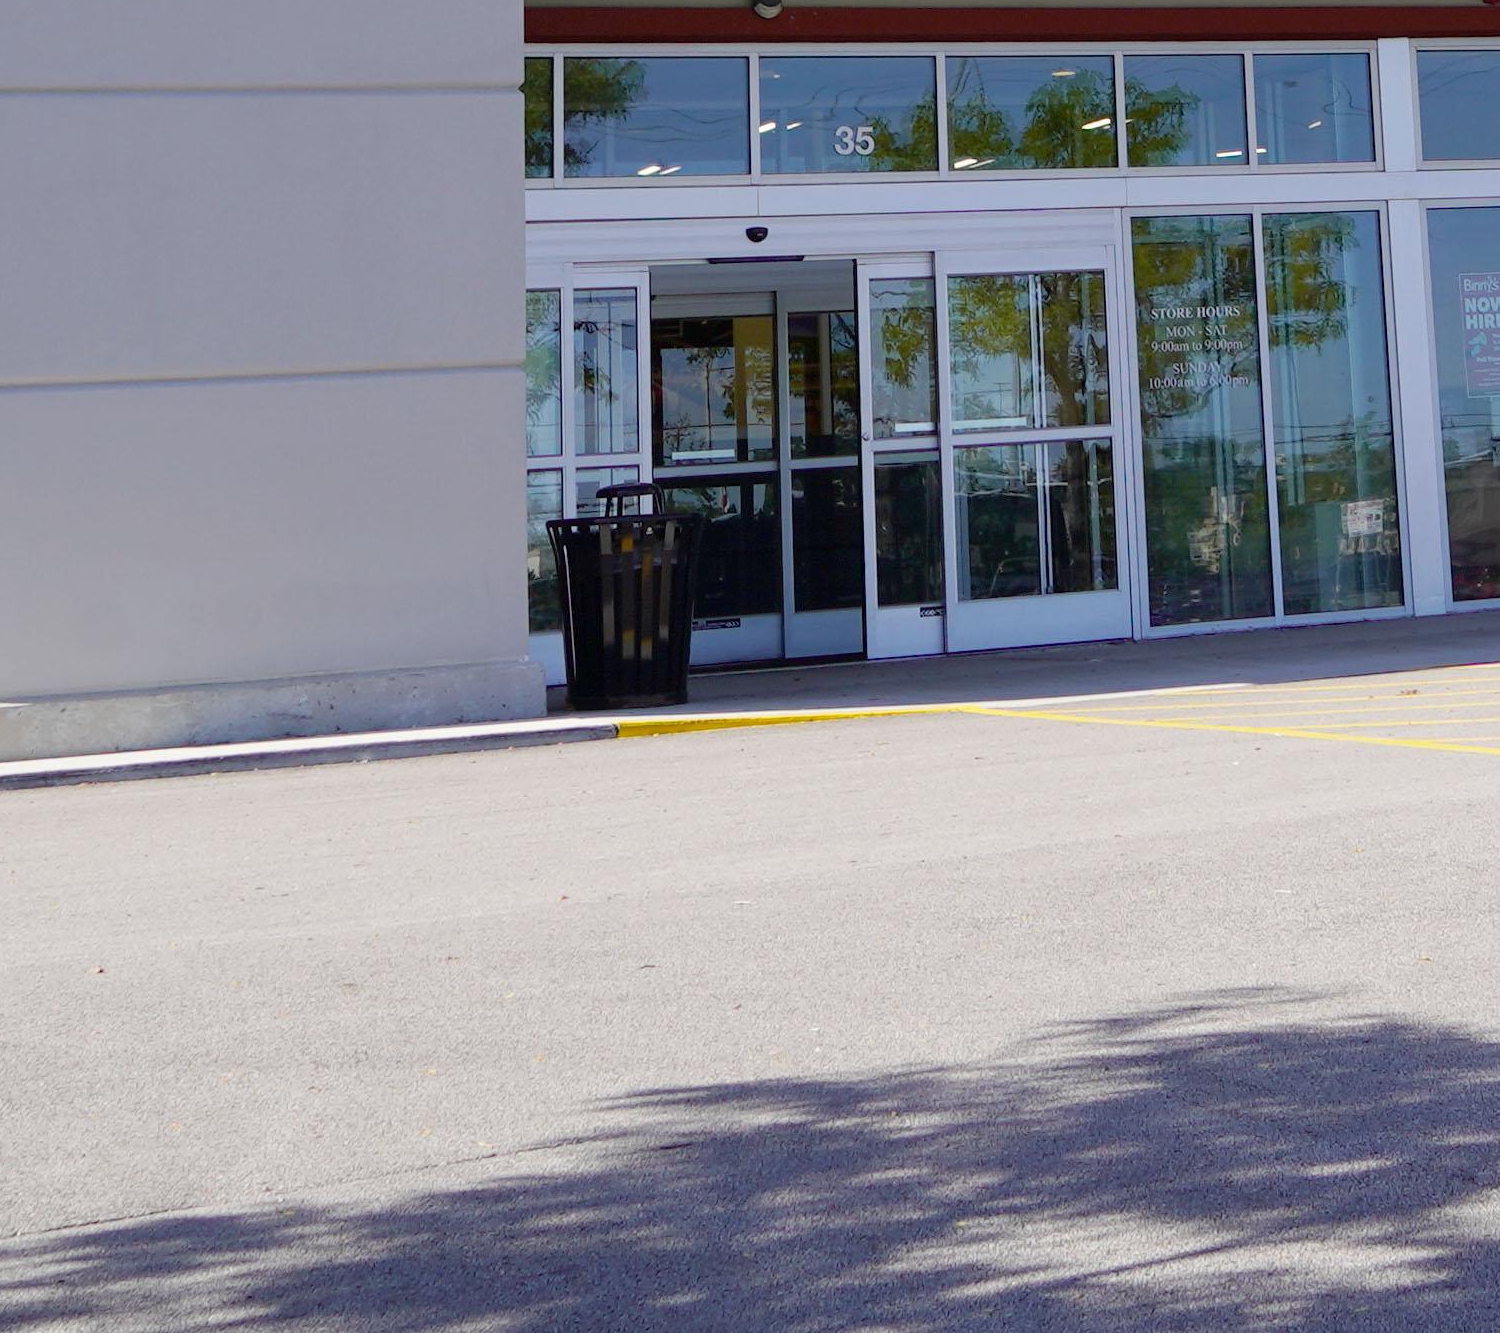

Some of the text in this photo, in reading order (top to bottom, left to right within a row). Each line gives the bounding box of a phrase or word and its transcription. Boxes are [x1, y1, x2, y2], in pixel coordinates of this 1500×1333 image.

[834, 125, 876, 156] 35
[1151, 306, 1241, 320] STORE HOURS
[1166, 326, 1196, 338] MON
[1204, 324, 1228, 336] SAT
[1151, 338, 1244, 353] 9:00am to 9:00pm
[1172, 362, 1222, 375] SUNDAY
[1149, 377, 1195, 390] 10:00am
[1196, 376, 1206, 387] to
